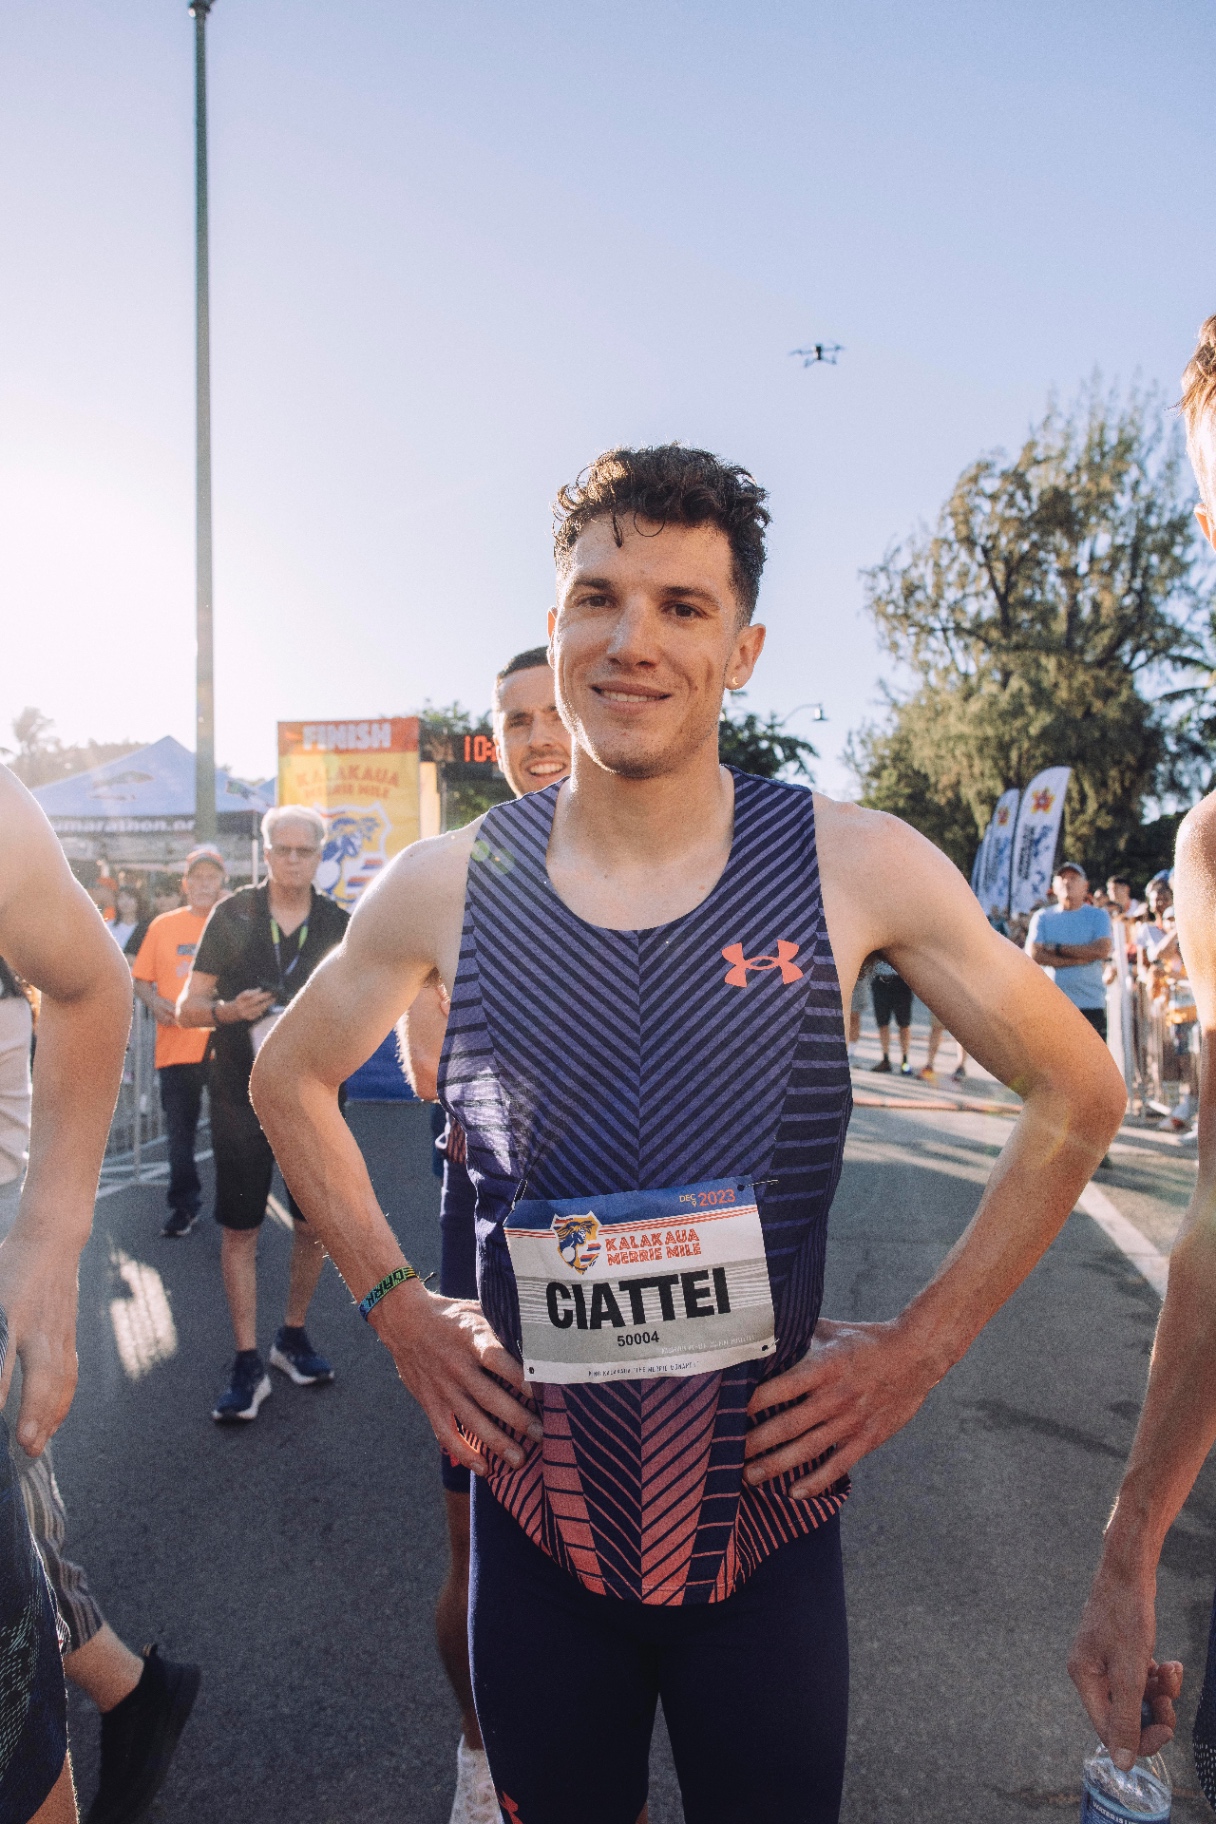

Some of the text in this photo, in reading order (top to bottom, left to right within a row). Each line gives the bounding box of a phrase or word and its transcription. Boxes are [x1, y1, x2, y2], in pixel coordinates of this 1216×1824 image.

[303, 723, 391, 750] FINISH
[679, 1194, 696, 1203] DEC
[698, 1188, 736, 1206] 2023
[605, 1228, 700, 1252] KALAKAUA
[607, 1243, 701, 1266] MERRIE MILE
[546, 1267, 731, 1330] CIATTEI
[617, 1330, 660, 1347] 50004
